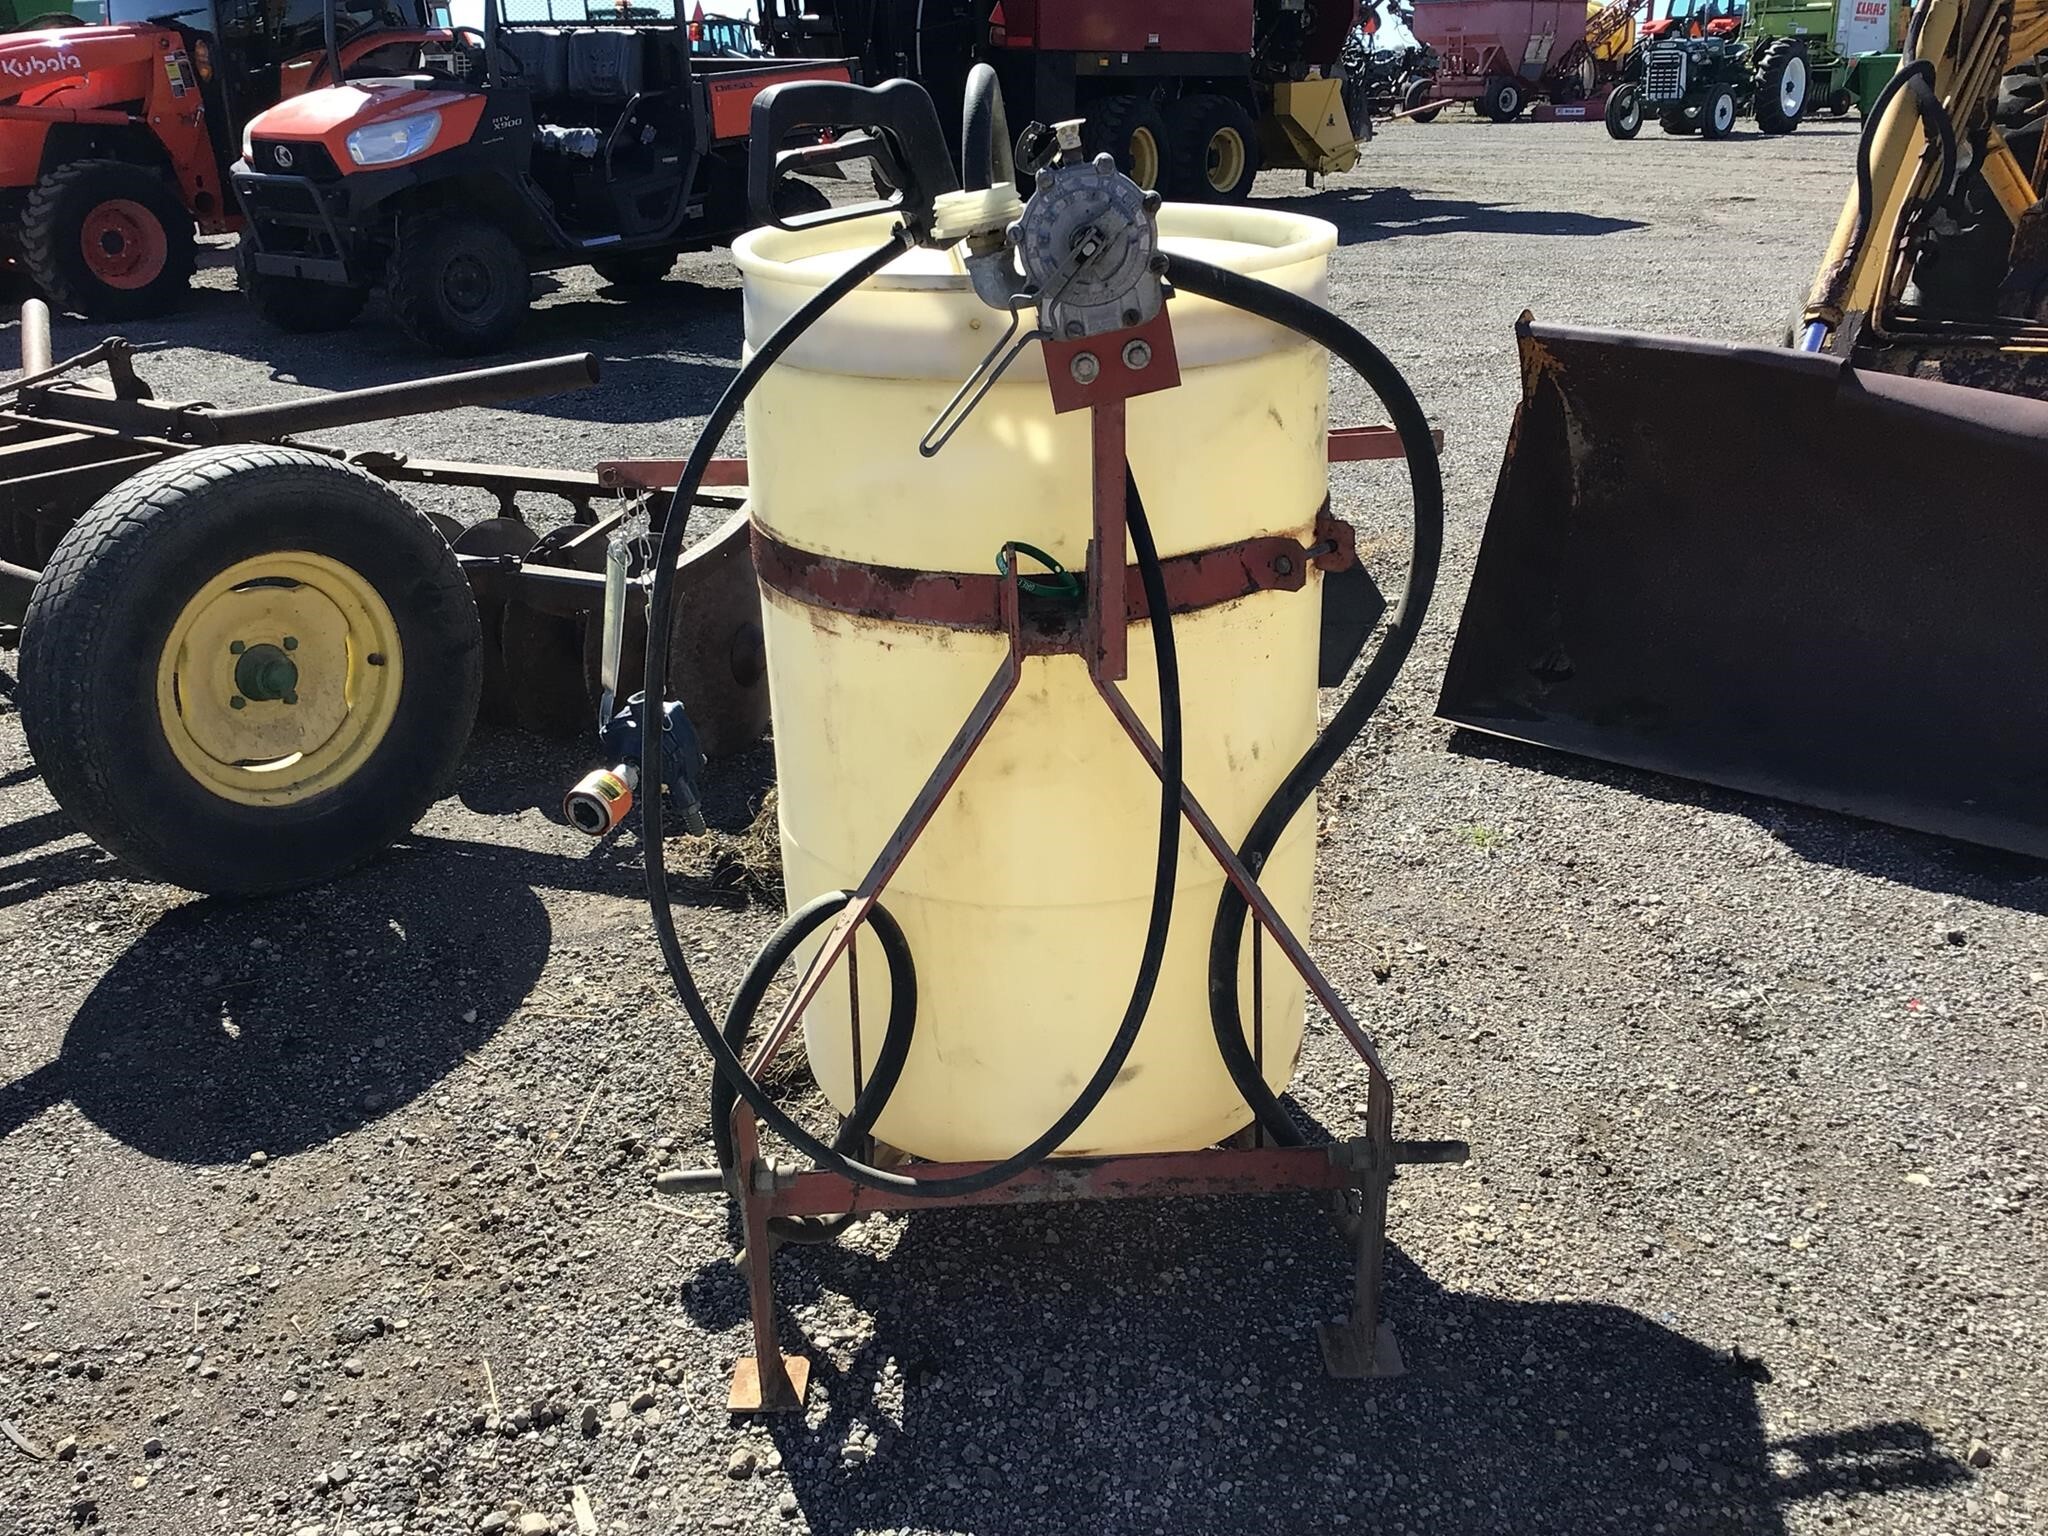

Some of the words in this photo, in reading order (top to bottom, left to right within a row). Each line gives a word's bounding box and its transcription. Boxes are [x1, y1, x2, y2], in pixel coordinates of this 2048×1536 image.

[1855, 1, 1888, 16] CLAAS
[1, 51, 81, 77] Kubota
[494, 118, 522, 130] X900
